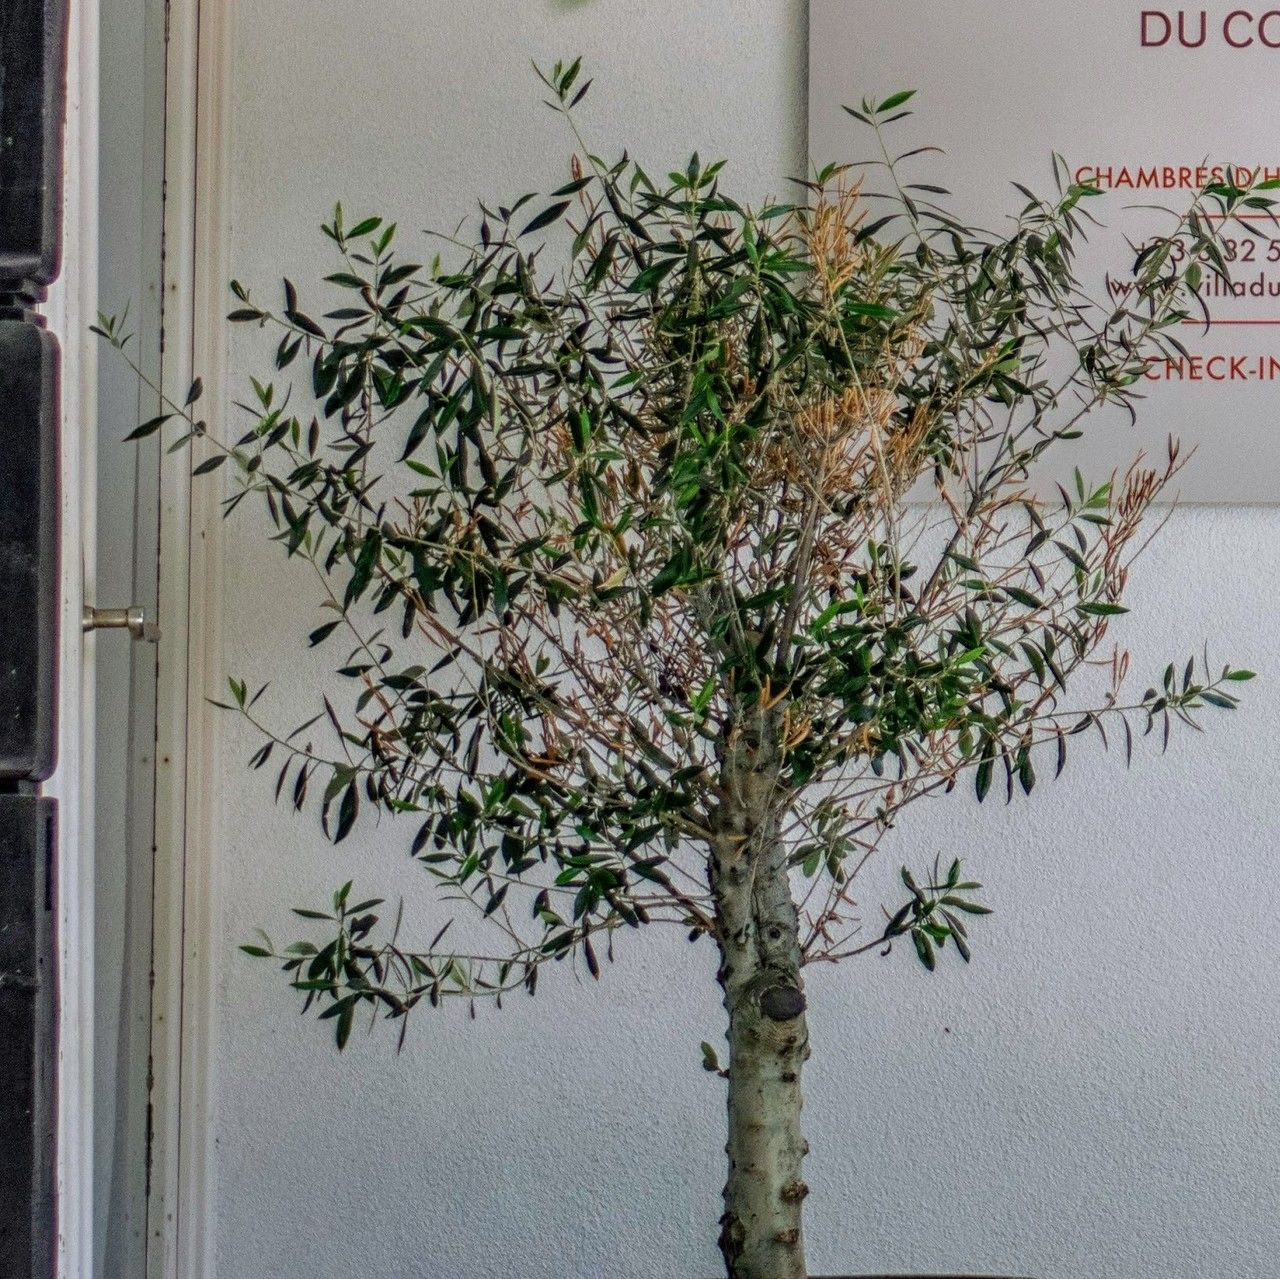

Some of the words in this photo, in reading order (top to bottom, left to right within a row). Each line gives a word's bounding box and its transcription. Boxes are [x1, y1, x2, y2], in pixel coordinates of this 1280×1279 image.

[1140, 10, 1207, 49] DU
[1075, 166, 1224, 189] CHAMBRES
[1223, 239, 1256, 262] 32
